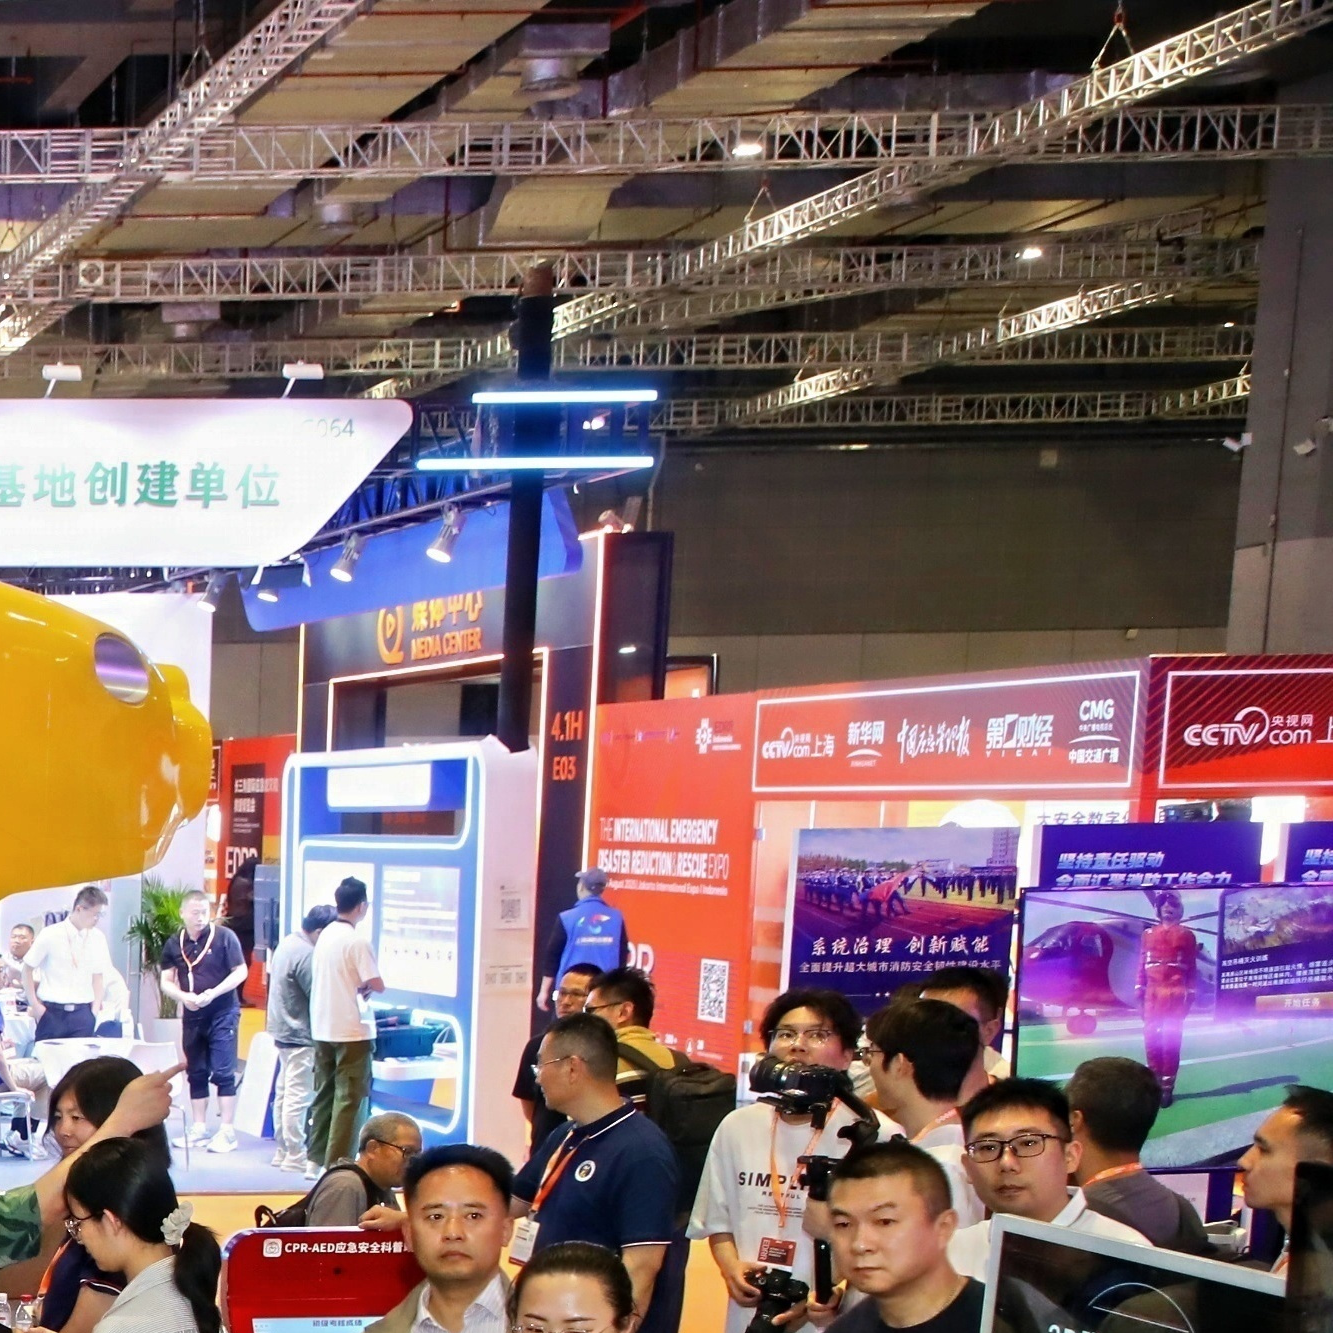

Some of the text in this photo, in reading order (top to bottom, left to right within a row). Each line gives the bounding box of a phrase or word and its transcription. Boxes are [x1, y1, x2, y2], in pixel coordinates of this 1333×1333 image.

[411, 627, 482, 661] MEDIA CENTER
[1079, 699, 1115, 721] CMG
[1271, 714, 1314, 727] 央视网
[550, 710, 584, 742] 4.1H
[847, 721, 885, 745] 新华网
[1184, 714, 1312, 746] CCTV com
[762, 734, 793, 758] CCTV
[811, 734, 835, 757] 上海
[1068, 747, 1119, 764] 中国交通广播
[552, 755, 577, 781] E03
[614, 818, 670, 844] INTERNATIONAL
[670, 818, 719, 845] EMERGENCY
[597, 849, 631, 873] DISASTER
[708, 853, 730, 880] EXPO
[1056, 851, 1165, 869] 坚持责任驱动
[811, 935, 990, 956] 系统治理 创新赋能
[285, 1241, 414, 1254] CPR-AED应急安全科普
